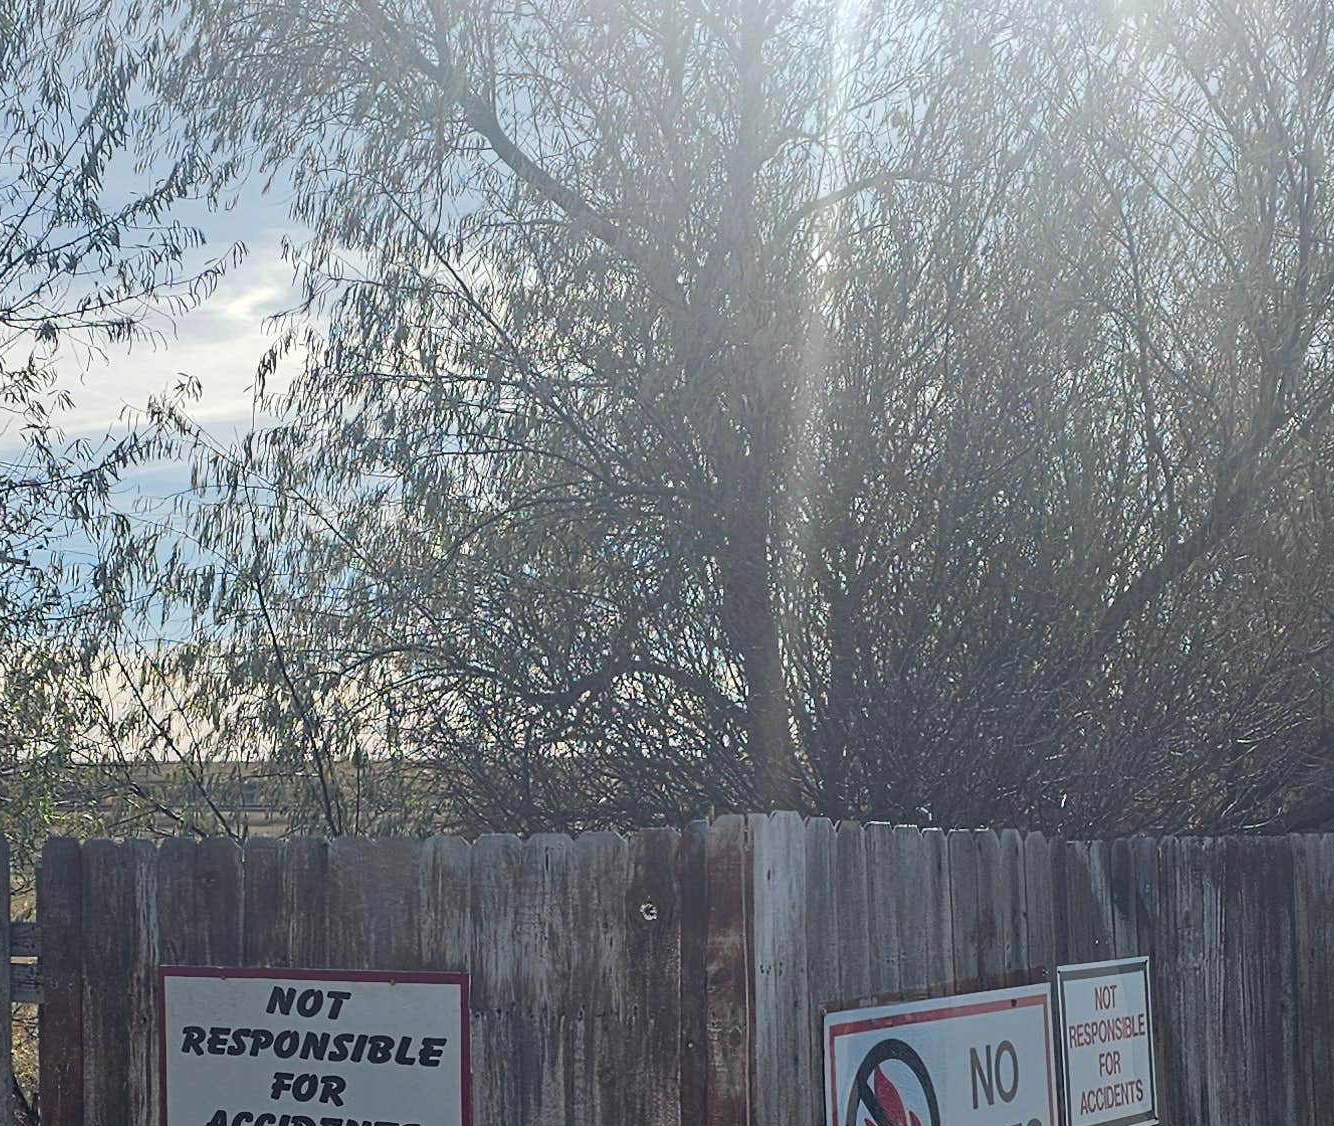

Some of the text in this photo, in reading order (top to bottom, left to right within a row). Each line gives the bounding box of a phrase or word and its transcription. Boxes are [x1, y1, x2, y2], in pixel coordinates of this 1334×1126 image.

[266, 986, 351, 1020] NOT
[1094, 985, 1118, 1011] NOT
[181, 1026, 447, 1067] RESPONSIBLE
[1069, 1014, 1146, 1048] RESPONSIBLE
[969, 1040, 1019, 1110] NO
[1099, 1051, 1121, 1077] FOR
[270, 1072, 346, 1107] FOR
[1080, 1079, 1144, 1115] ACCIDENTS
